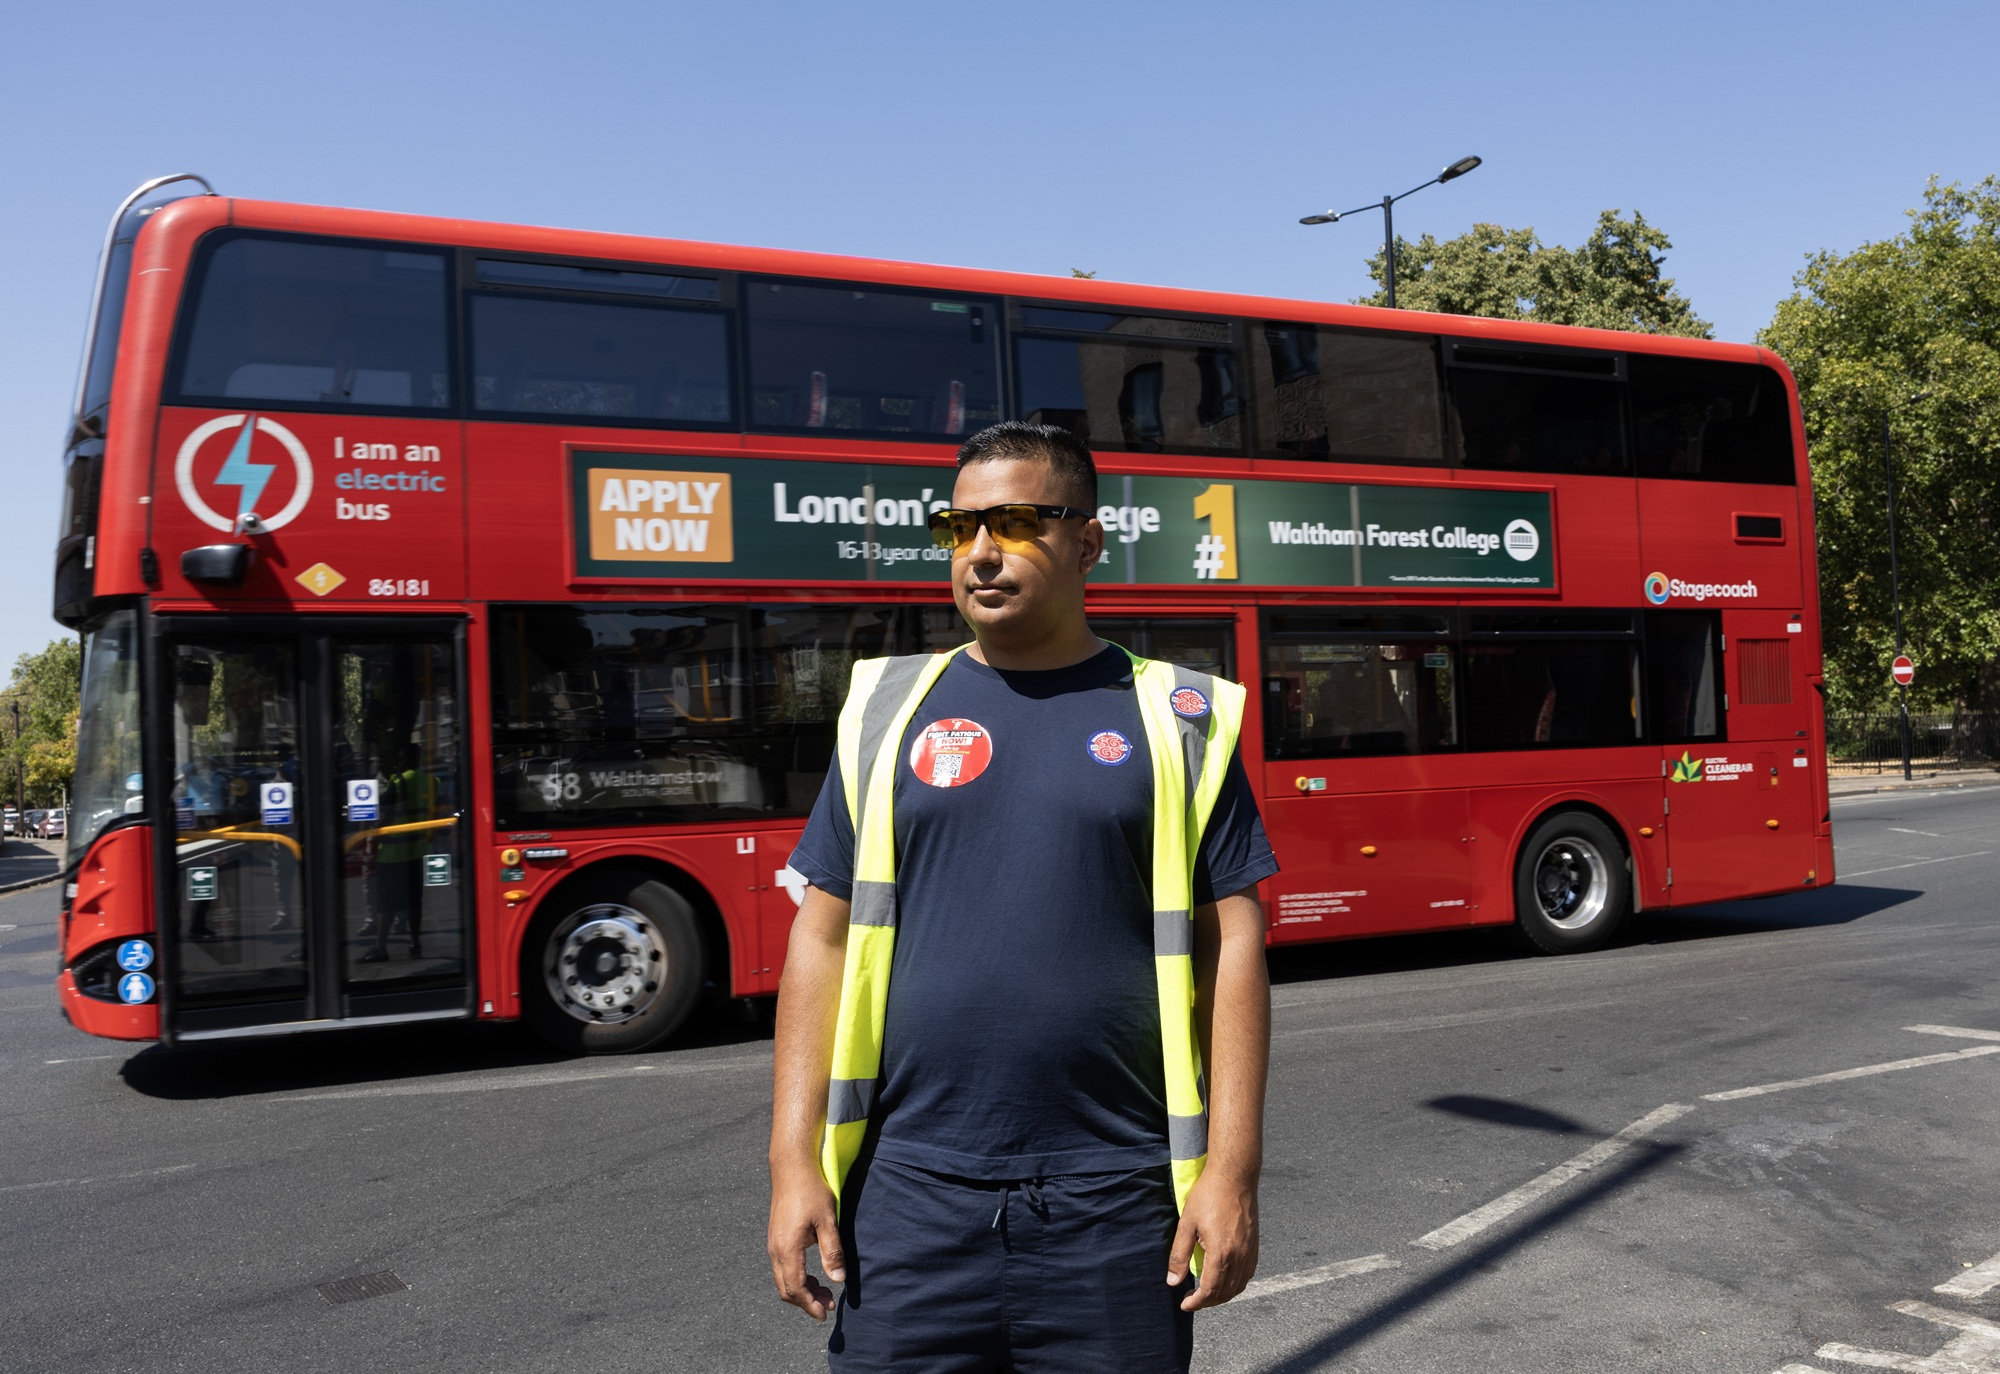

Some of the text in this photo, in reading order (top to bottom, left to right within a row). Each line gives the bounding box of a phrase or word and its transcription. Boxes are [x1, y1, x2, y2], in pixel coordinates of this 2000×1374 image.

[334, 437, 440, 462] I am an
[335, 468, 446, 492] electric
[599, 478, 722, 514] APPLY
[336, 498, 391, 521] bus
[615, 517, 710, 552] NOW
[1268, 521, 1500, 555] Waltham Forest College
[882, 548, 921, 565] year
[368, 579, 430, 596] 86181
[1669, 578, 1758, 601] Stagecoach
[589, 770, 723, 788] Walthamstow
